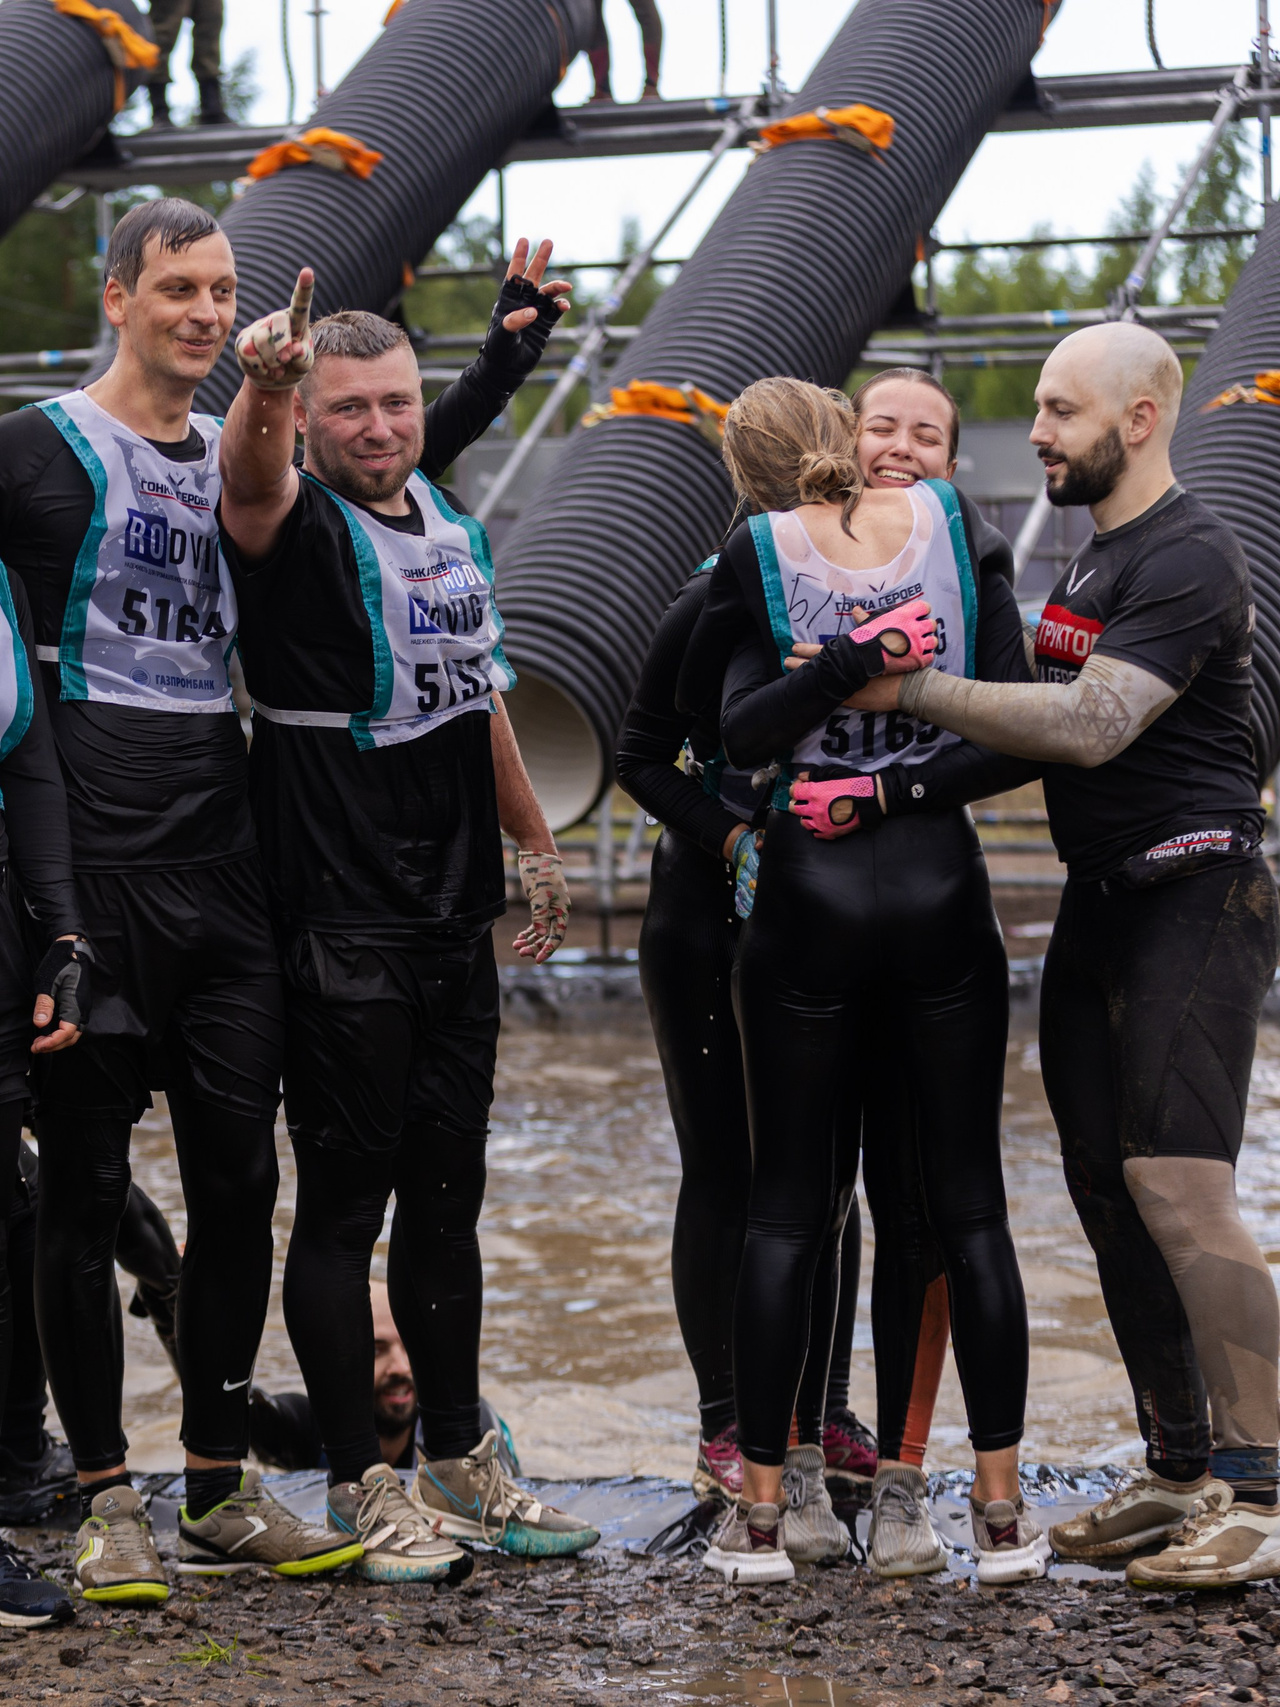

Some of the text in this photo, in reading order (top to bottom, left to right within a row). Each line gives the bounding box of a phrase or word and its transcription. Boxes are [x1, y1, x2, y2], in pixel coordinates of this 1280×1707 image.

[176, 491, 210, 506] ГЕРОЕВ
[835, 583, 922, 612] ГОНКА ГЕРОЕВ
[118, 587, 228, 644] 5164
[156, 675, 215, 690] ГАЗПРОМБАНК
[1146, 842, 1229, 860] ГОНКА ГЕРОЕВ
